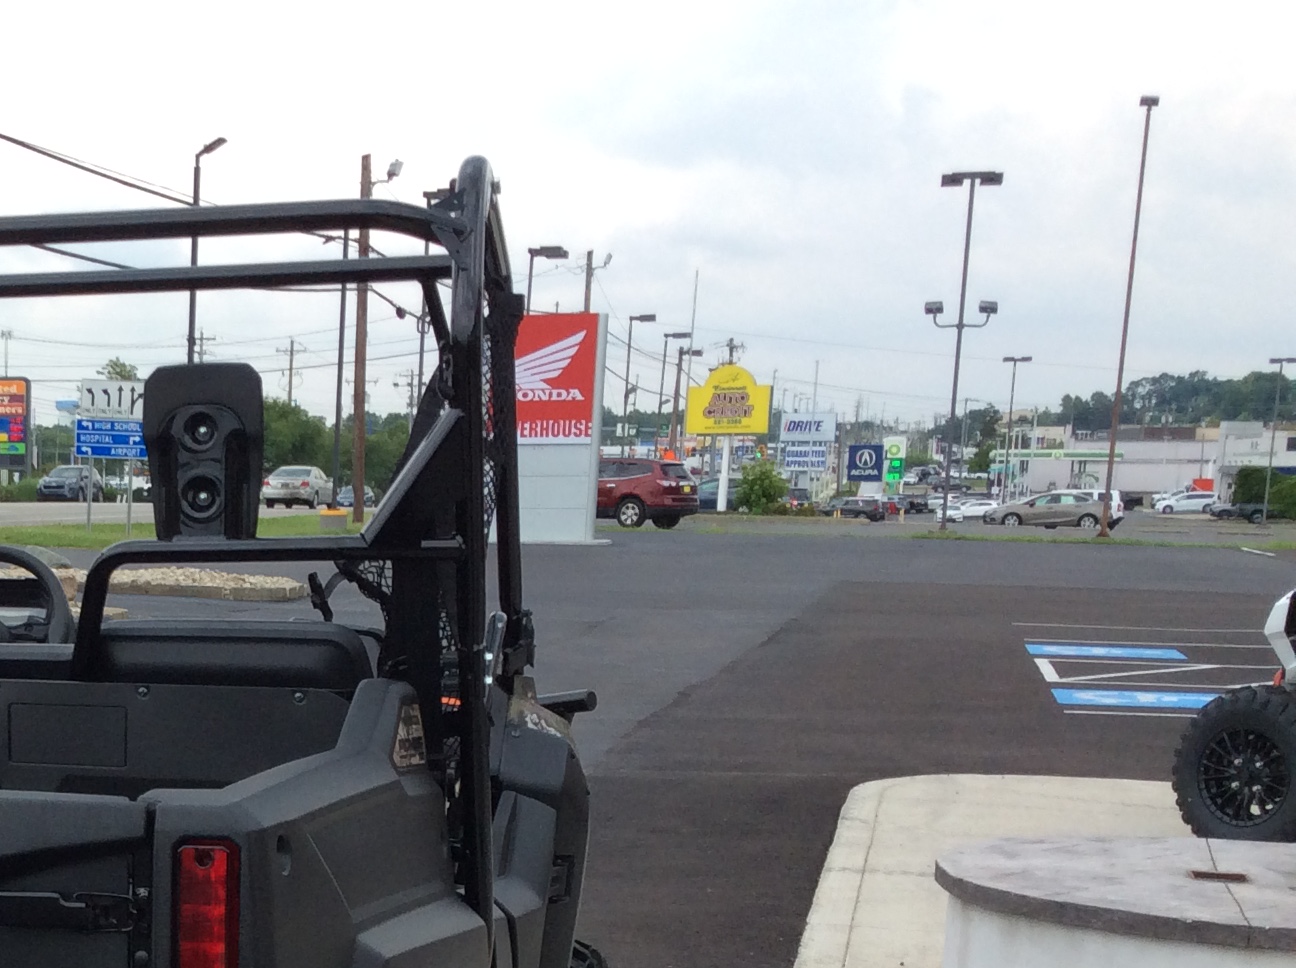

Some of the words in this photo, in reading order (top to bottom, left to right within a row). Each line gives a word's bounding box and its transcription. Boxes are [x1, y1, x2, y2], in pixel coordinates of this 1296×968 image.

[516, 389, 585, 401] ONDA
[708, 391, 750, 407] AUTO
[703, 404, 755, 419] CREDIT
[94, 421, 112, 430] HIGH
[113, 422, 141, 432] SCHOOL
[518, 420, 592, 438] ERHOUSE
[783, 420, 824, 432] iDRIVE
[80, 434, 113, 444] HOSPITAL
[110, 447, 141, 457] AIRPORT
[786, 449, 826, 458] GUARATEED
